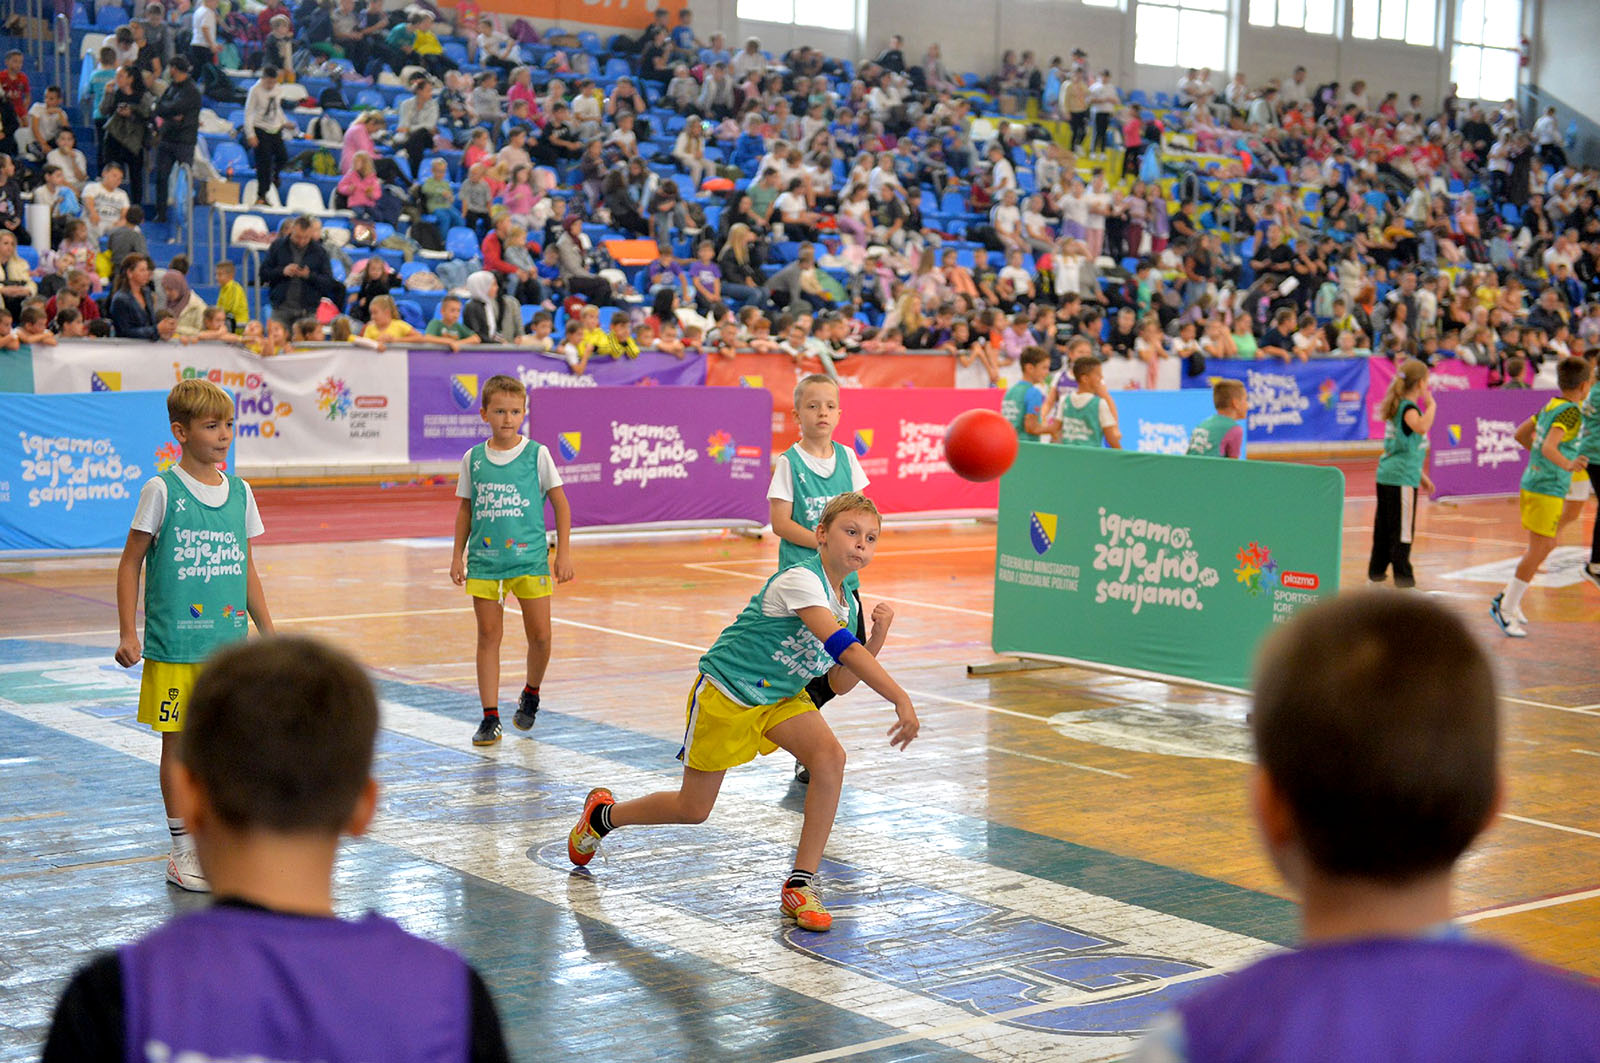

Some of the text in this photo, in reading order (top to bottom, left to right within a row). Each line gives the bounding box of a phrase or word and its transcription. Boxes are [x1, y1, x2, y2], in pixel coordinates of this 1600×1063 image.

[173, 526, 237, 547] igramo.
[1097, 506, 1194, 547] igramo.
[178, 560, 242, 584] sanjamo.
[1283, 574, 1315, 586] plazma
[1095, 574, 1204, 614] sanjamo.
[1273, 602, 1294, 614] IGRE
[158, 700, 180, 722] 54
